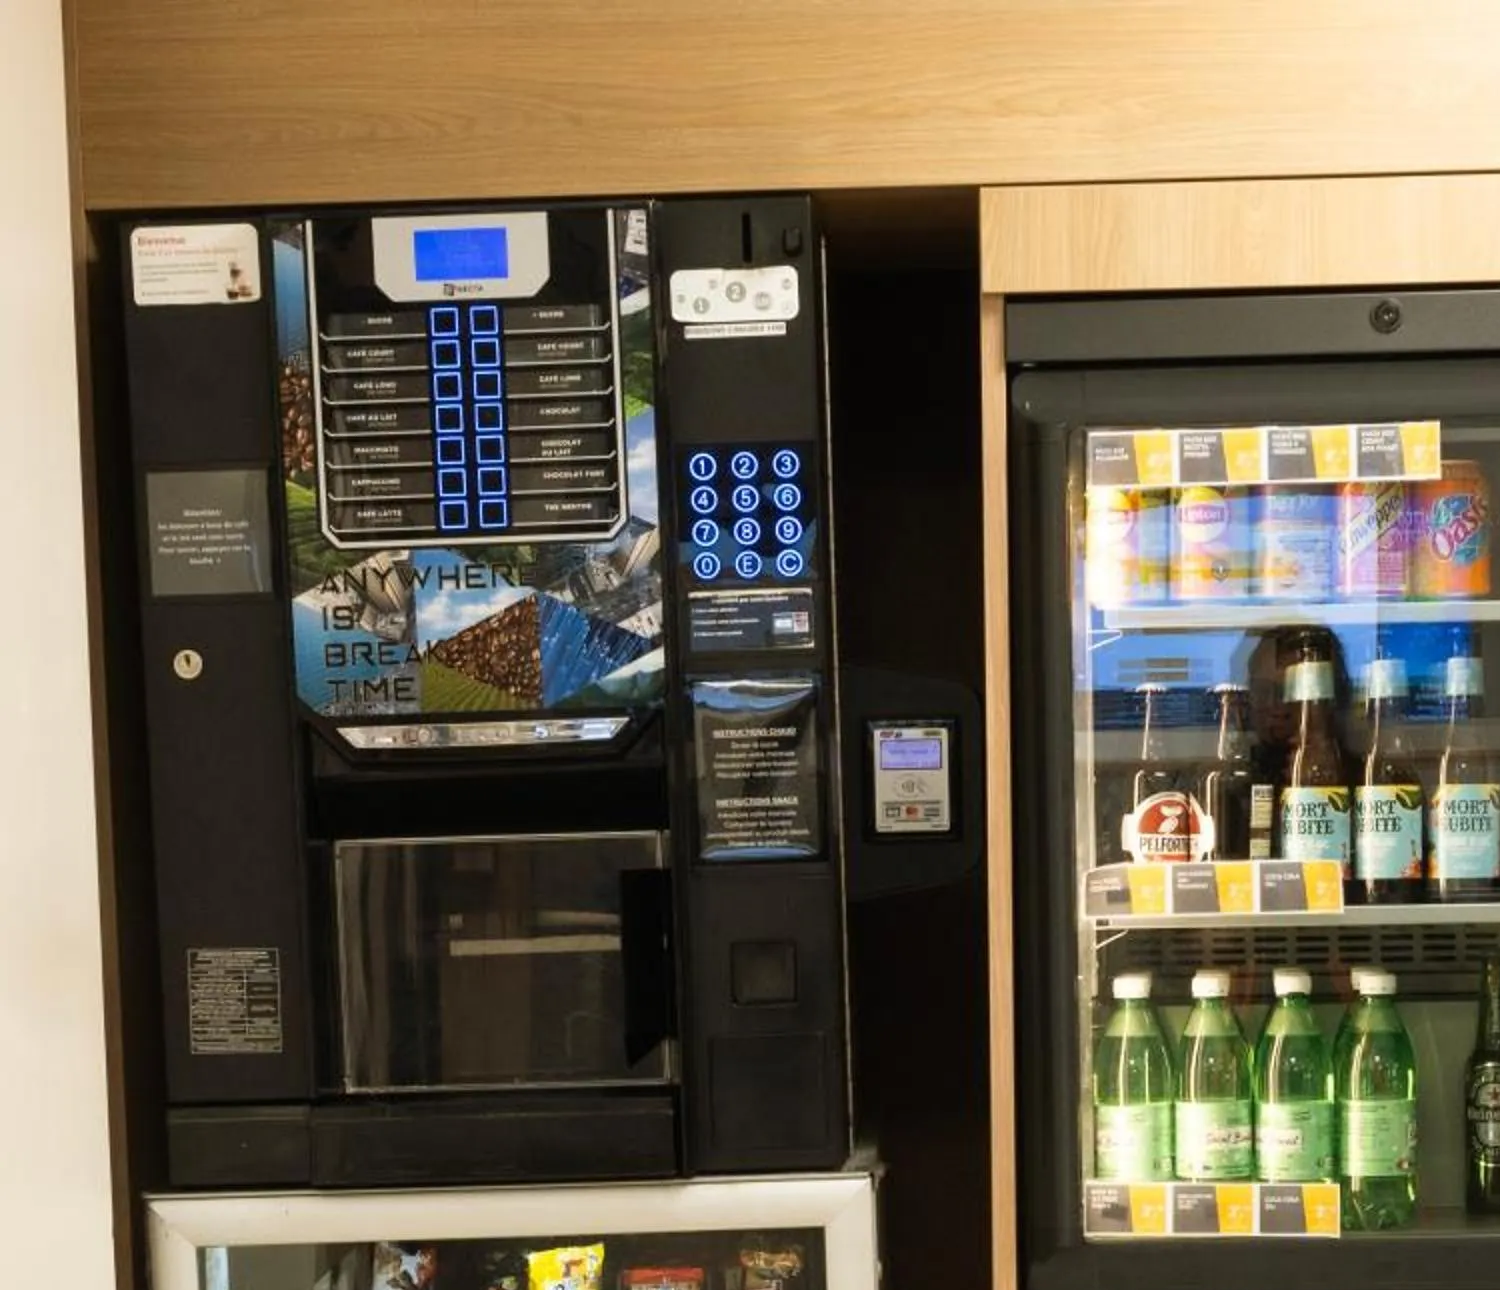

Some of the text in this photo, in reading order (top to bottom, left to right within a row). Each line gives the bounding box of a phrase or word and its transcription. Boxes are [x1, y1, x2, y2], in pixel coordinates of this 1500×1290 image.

[320, 561, 538, 595] ANYWHERE
[322, 604, 353, 632] IS
[324, 639, 446, 668] BREAK
[326, 676, 418, 703] TIME
